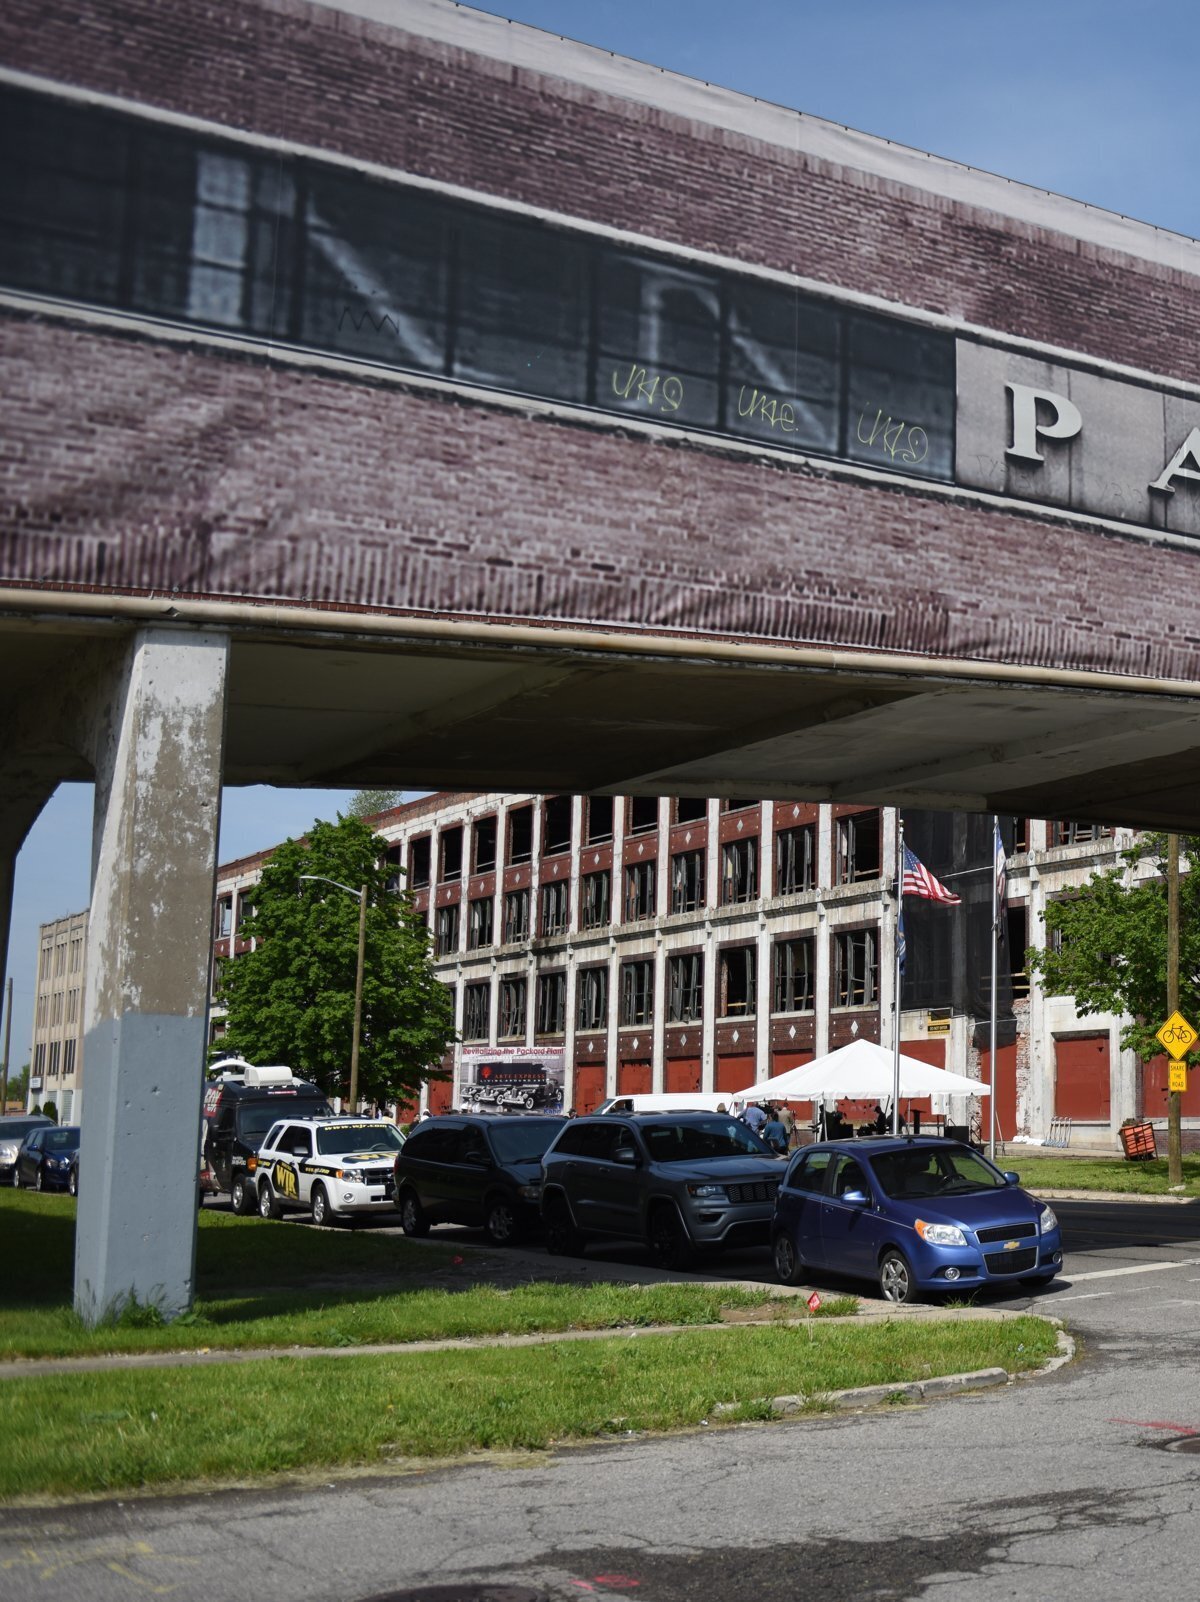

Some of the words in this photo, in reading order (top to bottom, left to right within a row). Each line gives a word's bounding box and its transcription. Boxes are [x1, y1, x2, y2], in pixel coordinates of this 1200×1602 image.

[462, 1047, 503, 1057] Revitalizing
[503, 1047, 515, 1055] the
[516, 1047, 546, 1055] Packard
[546, 1047, 564, 1055] Plant
[324, 1123, 388, 1131] www.wjr.com
[276, 1164, 298, 1196] WJR
